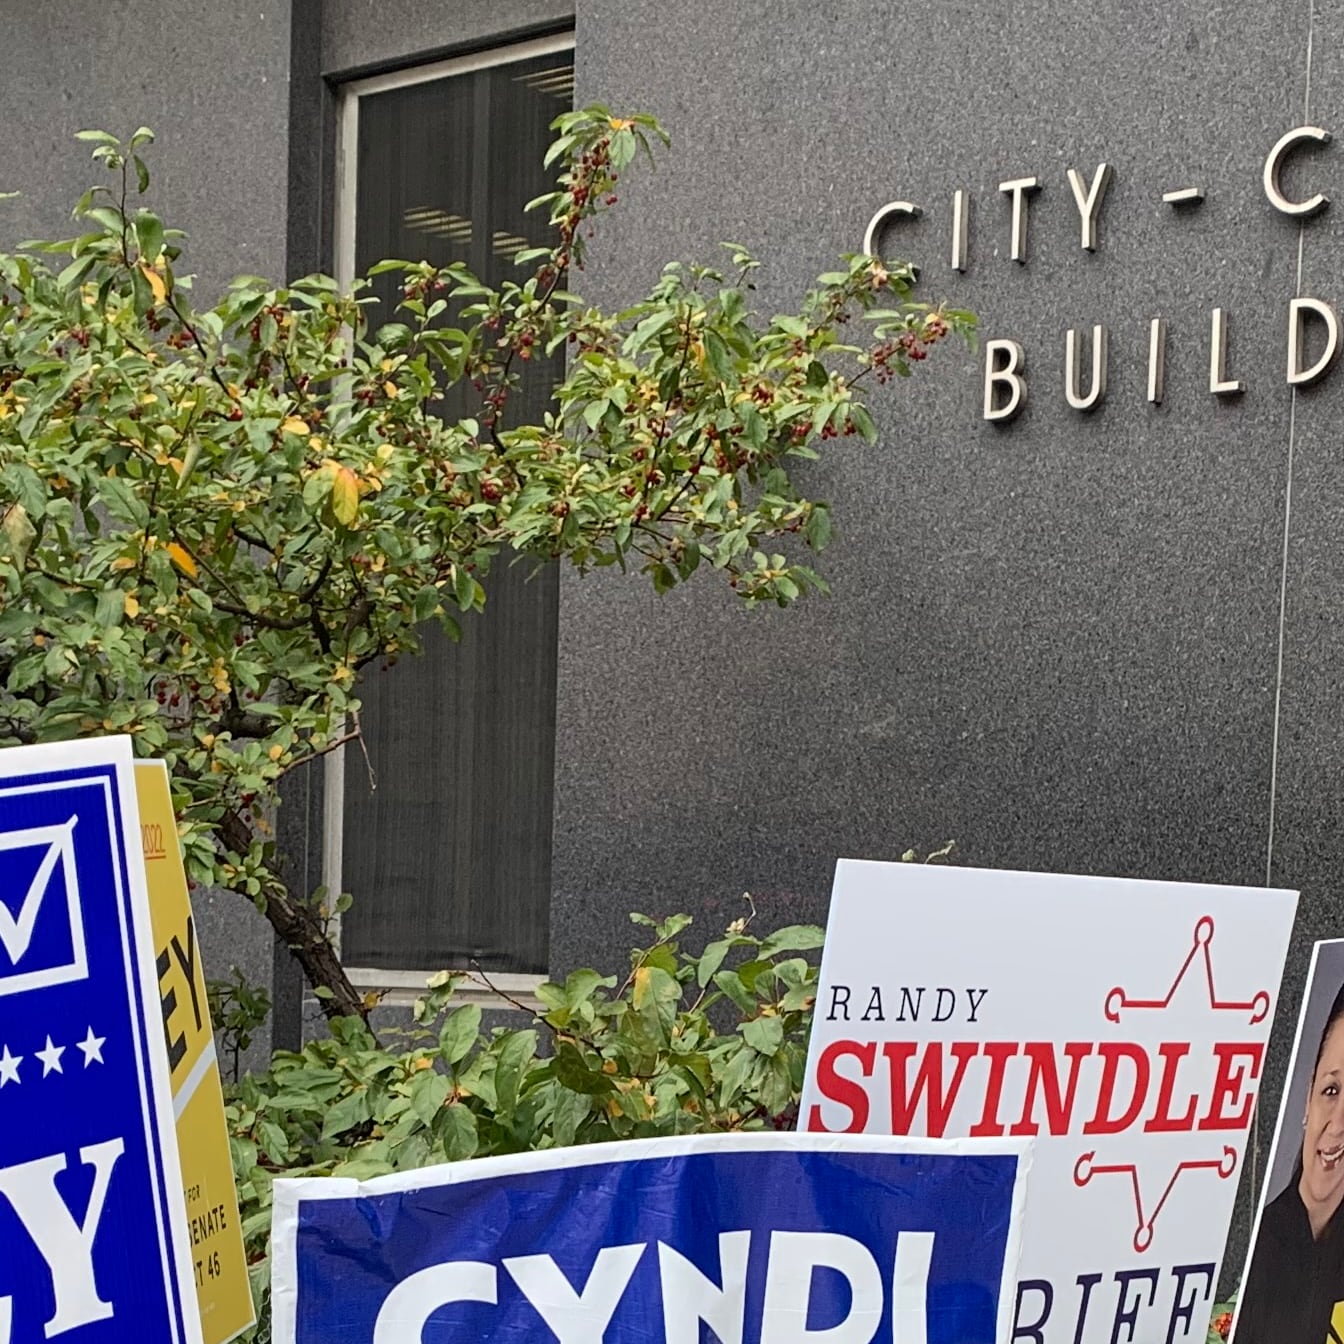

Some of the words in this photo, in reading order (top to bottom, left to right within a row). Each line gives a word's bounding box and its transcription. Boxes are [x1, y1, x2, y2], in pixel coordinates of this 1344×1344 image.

[863, 163, 1111, 280] CITY
[826, 985, 989, 1023] RANDY
[807, 1040, 1266, 1138] SWINDLE
[188, 1184, 201, 1203] FOR
[207, 1251, 221, 1281] 46
